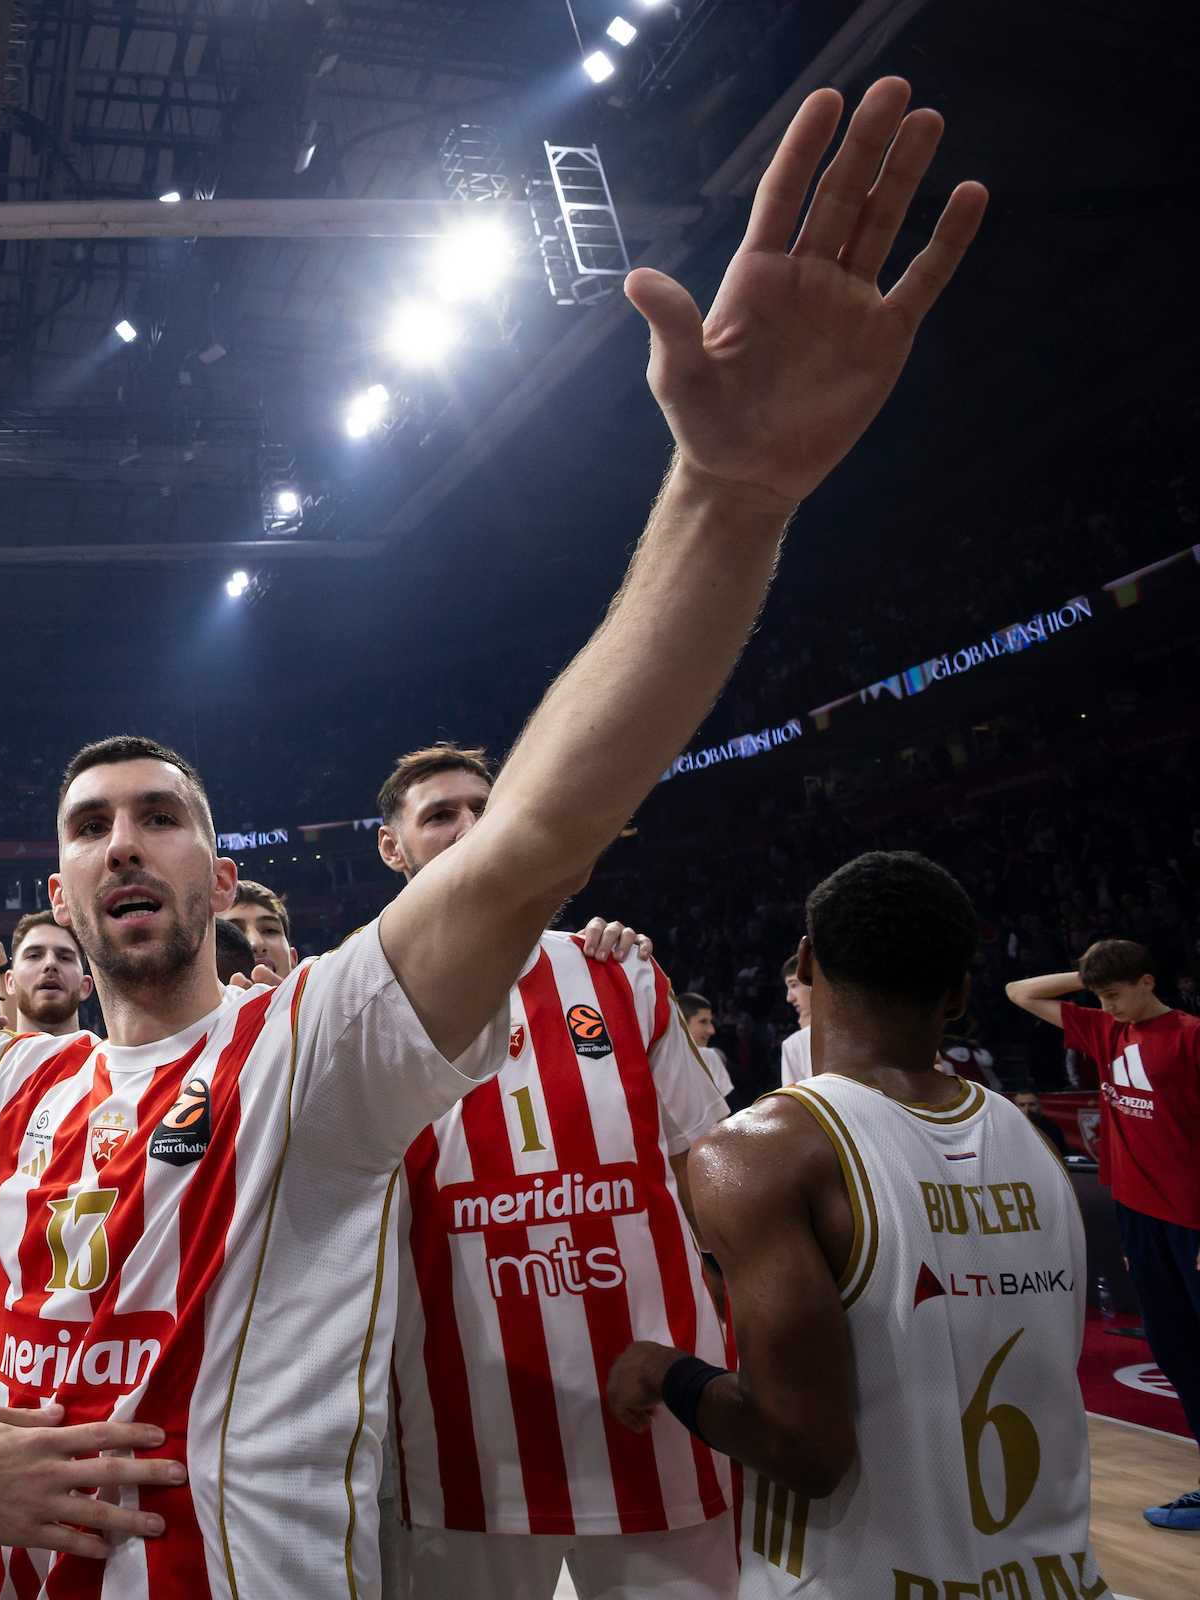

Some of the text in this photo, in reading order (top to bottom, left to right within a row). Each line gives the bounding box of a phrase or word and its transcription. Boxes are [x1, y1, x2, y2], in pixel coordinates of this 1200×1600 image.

[931, 598, 1092, 680] GLOBAL FASHION
[678, 721, 802, 773] GLOBAL FASHION
[229, 830, 289, 849] FASHION
[509, 1085, 548, 1154] 1
[1119, 1095, 1154, 1111] ZVEZDA
[153, 1142, 207, 1154] abu dhabi
[453, 1173, 635, 1228] meridian
[918, 1181, 1042, 1235] BUTLER
[489, 1237, 624, 1297] mts
[961, 1327, 1040, 1536] 6
